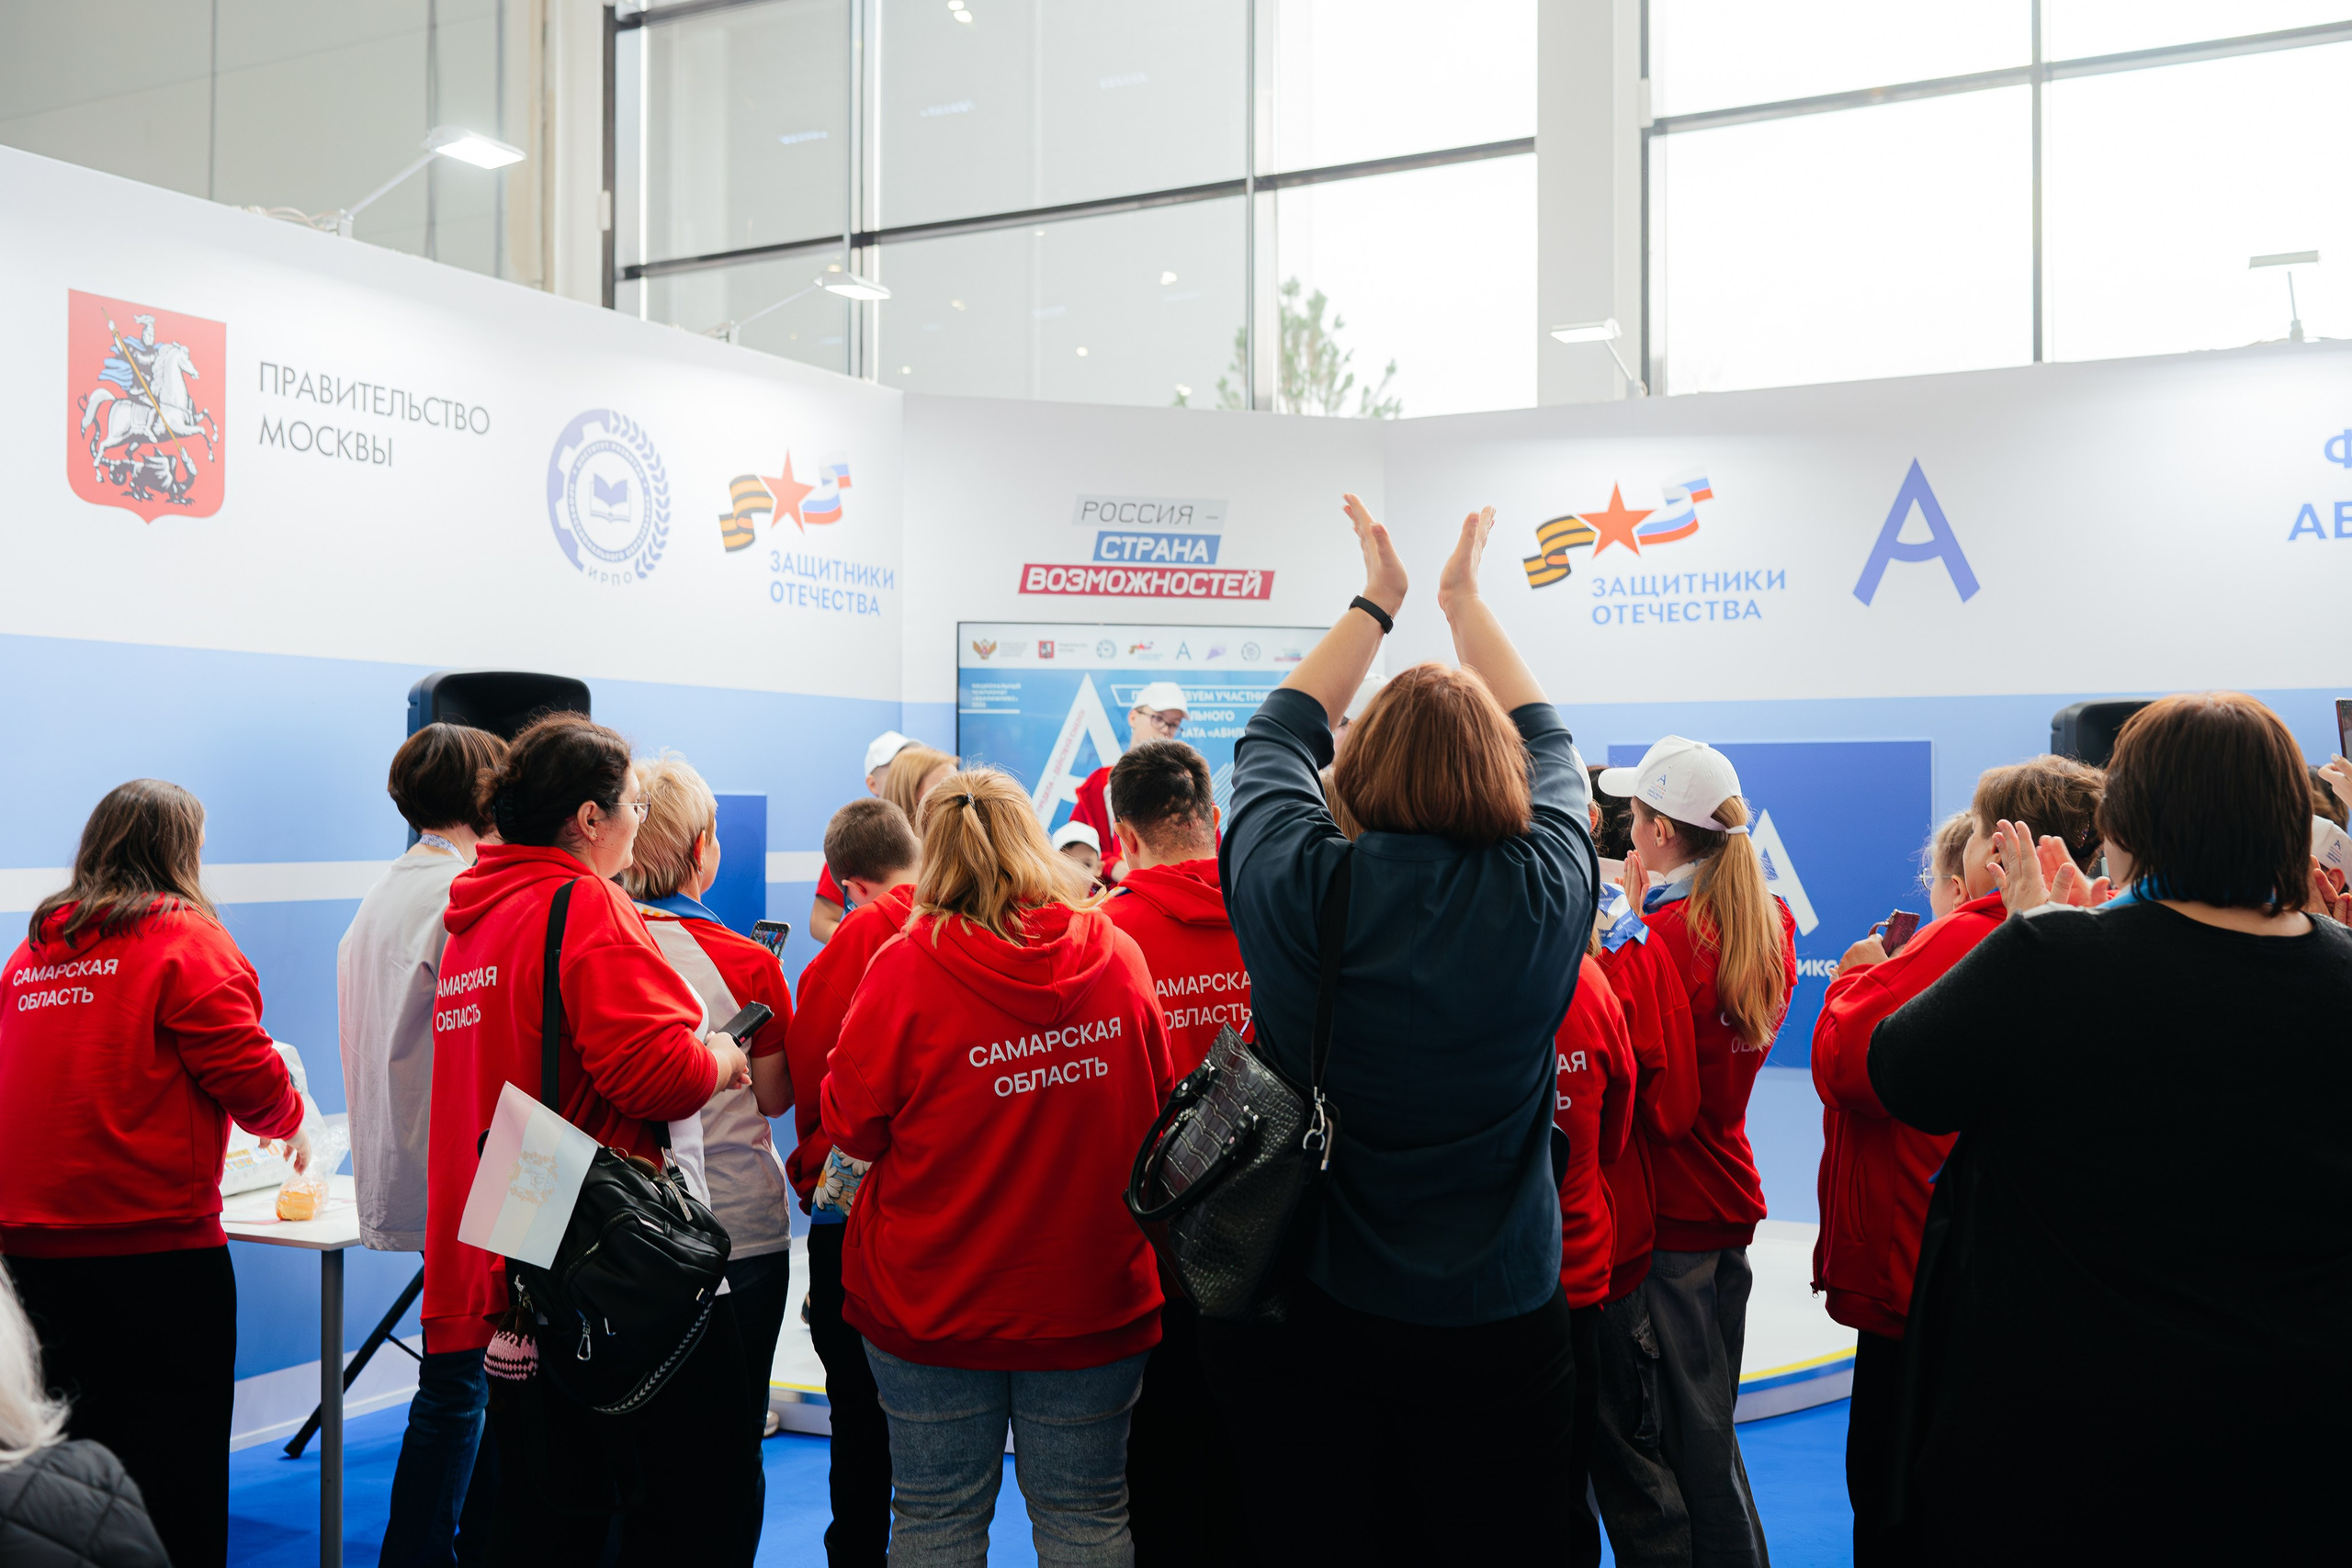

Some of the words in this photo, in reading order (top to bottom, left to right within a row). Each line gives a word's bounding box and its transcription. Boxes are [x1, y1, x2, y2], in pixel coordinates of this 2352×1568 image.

[258, 360, 491, 435] ПРАВИТЕЛЬСТВО
[258, 415, 393, 467] МОСКВЫ
[1080, 501, 1194, 525] РОССИЯ
[1100, 536, 1210, 563] СТРАНА
[588, 565, 633, 587] ИРПО
[770, 550, 895, 591] ЗАЩИТНИКИ
[1025, 566, 1263, 598] ВОЗМОЖНОСТЕЙ
[1591, 569, 1786, 598] ЗАЩИТНИКИ
[770, 581, 881, 616] ОТЕЧЕСТВА
[1591, 599, 1762, 626] ОТЕЧЕСТВА
[12, 958, 119, 987] САМАРСКАЯ
[436, 965, 498, 999] АМАРСКАЯ
[1155, 970, 1251, 998] АМАРСКА
[17, 987, 94, 1012] ОБЛАСТЬ
[436, 1003, 481, 1032] ОБЛАСТЬ
[1164, 1002, 1252, 1031] ОБЛАСТЬ
[968, 1016, 1122, 1068] САМАРСКАЯ
[994, 1056, 1108, 1098] ОБЛАСТЬ
